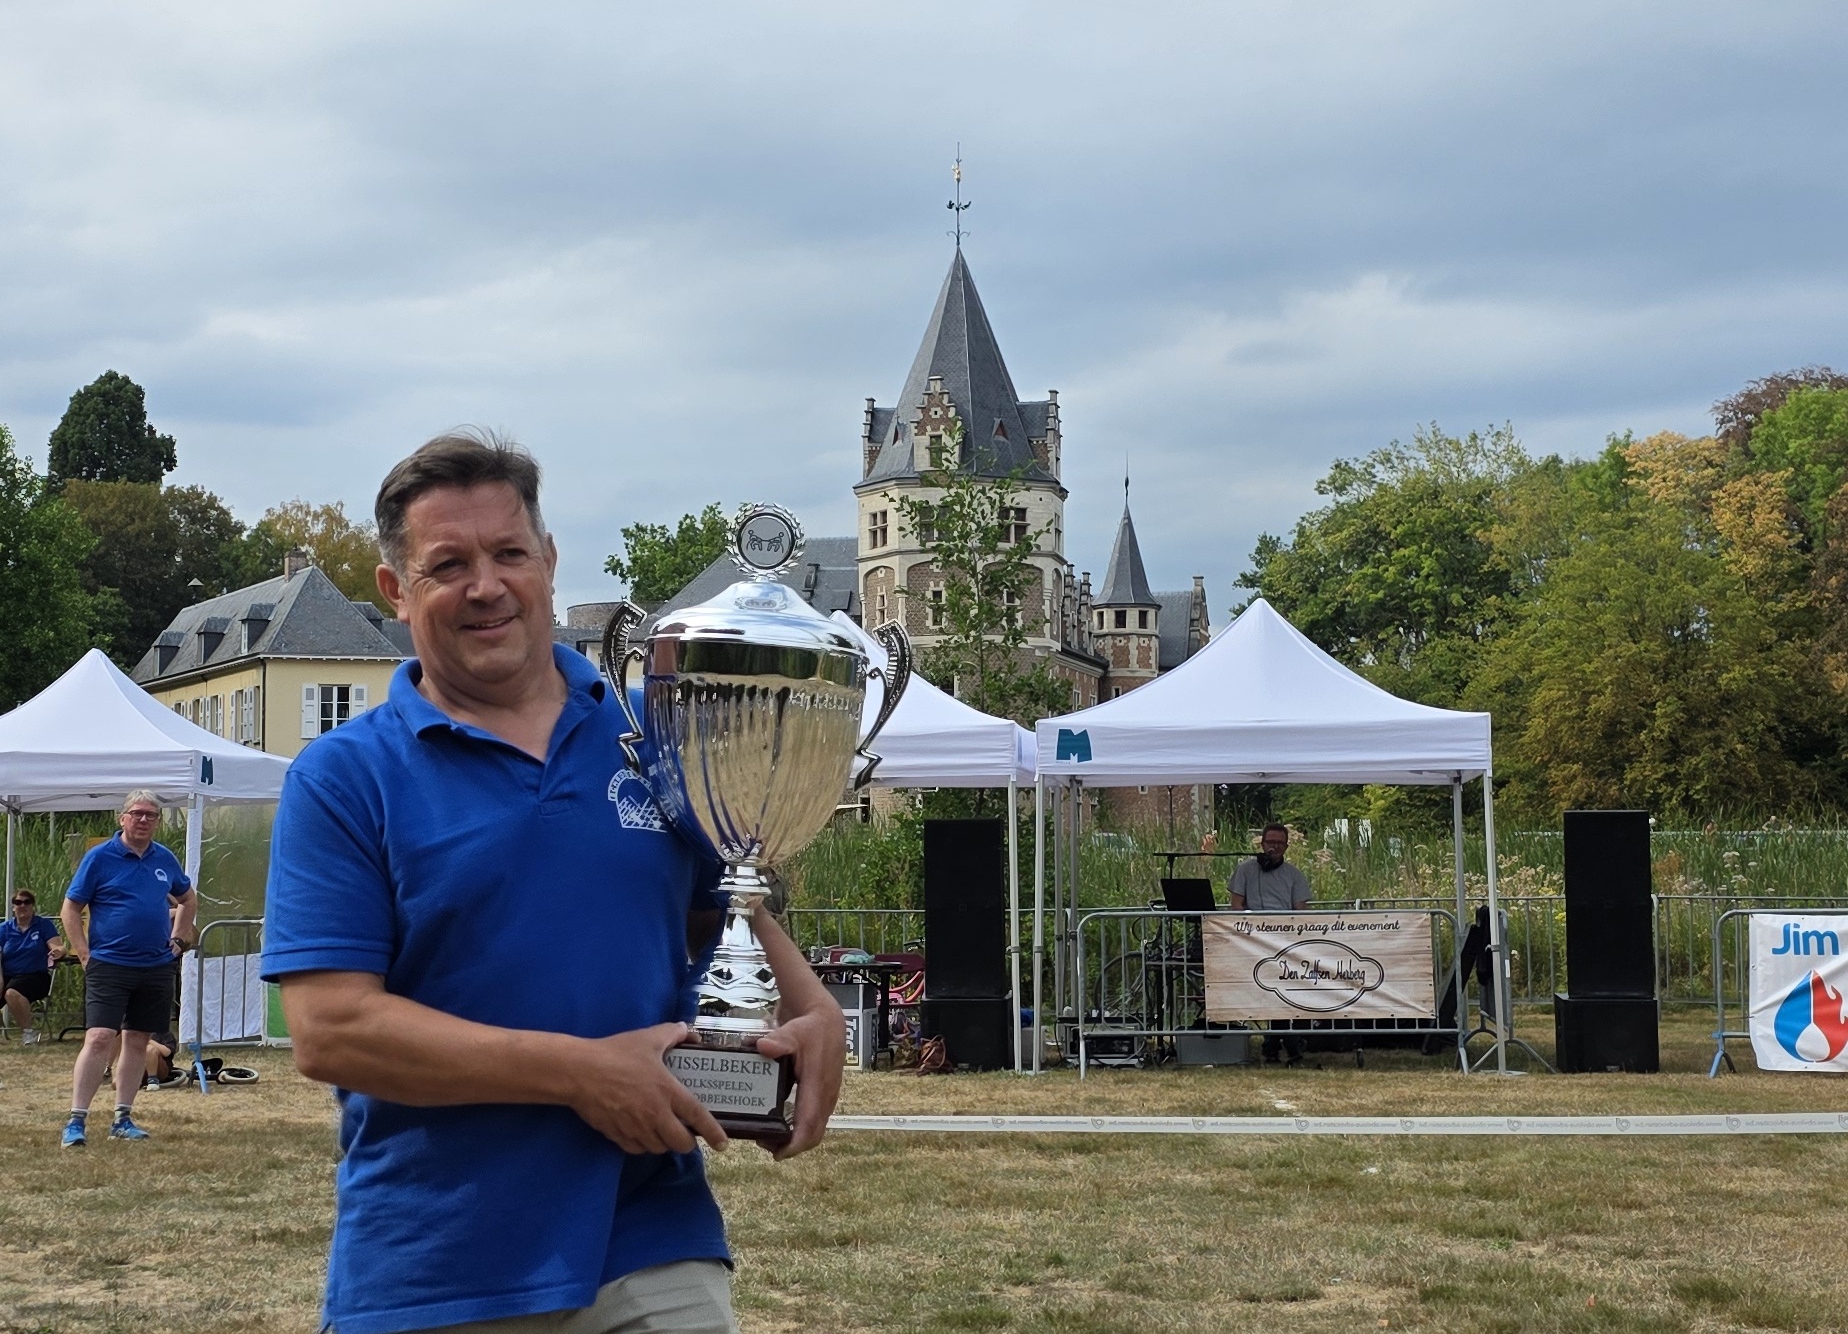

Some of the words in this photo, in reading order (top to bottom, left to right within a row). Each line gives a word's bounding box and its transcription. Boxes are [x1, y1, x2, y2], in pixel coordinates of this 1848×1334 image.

[1056, 728, 1092, 763] M
[1255, 921, 1295, 932] steunen
[1296, 922, 1329, 936] graag
[1331, 920, 1346, 931] dit
[1347, 919, 1400, 931] evenement
[1772, 923, 1839, 956] Jim
[1279, 959, 1299, 980] Den
[1332, 958, 1366, 985] Herberg
[664, 1055, 773, 1076] WISSELBEKER
[694, 1092, 766, 1108] OBBERSHOEK
